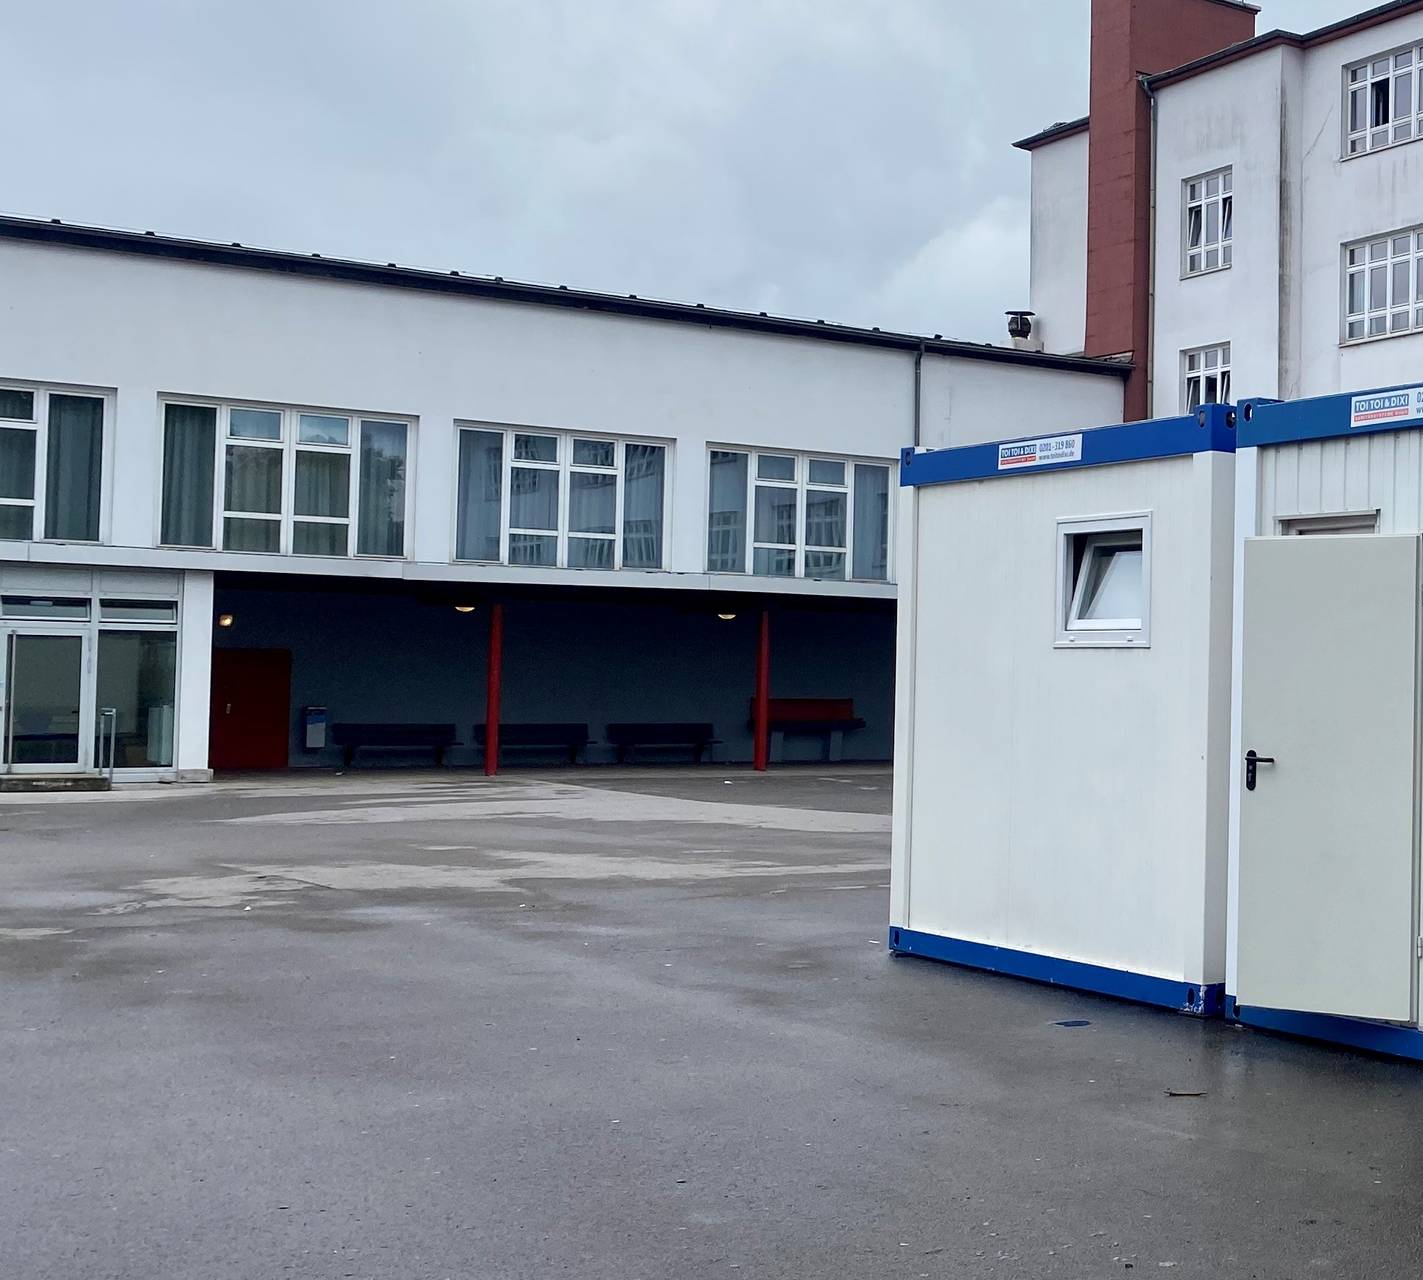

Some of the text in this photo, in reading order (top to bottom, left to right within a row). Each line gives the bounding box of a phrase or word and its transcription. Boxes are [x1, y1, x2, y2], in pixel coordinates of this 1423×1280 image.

[1356, 395, 1408, 412] TOI TOI & DIXI
